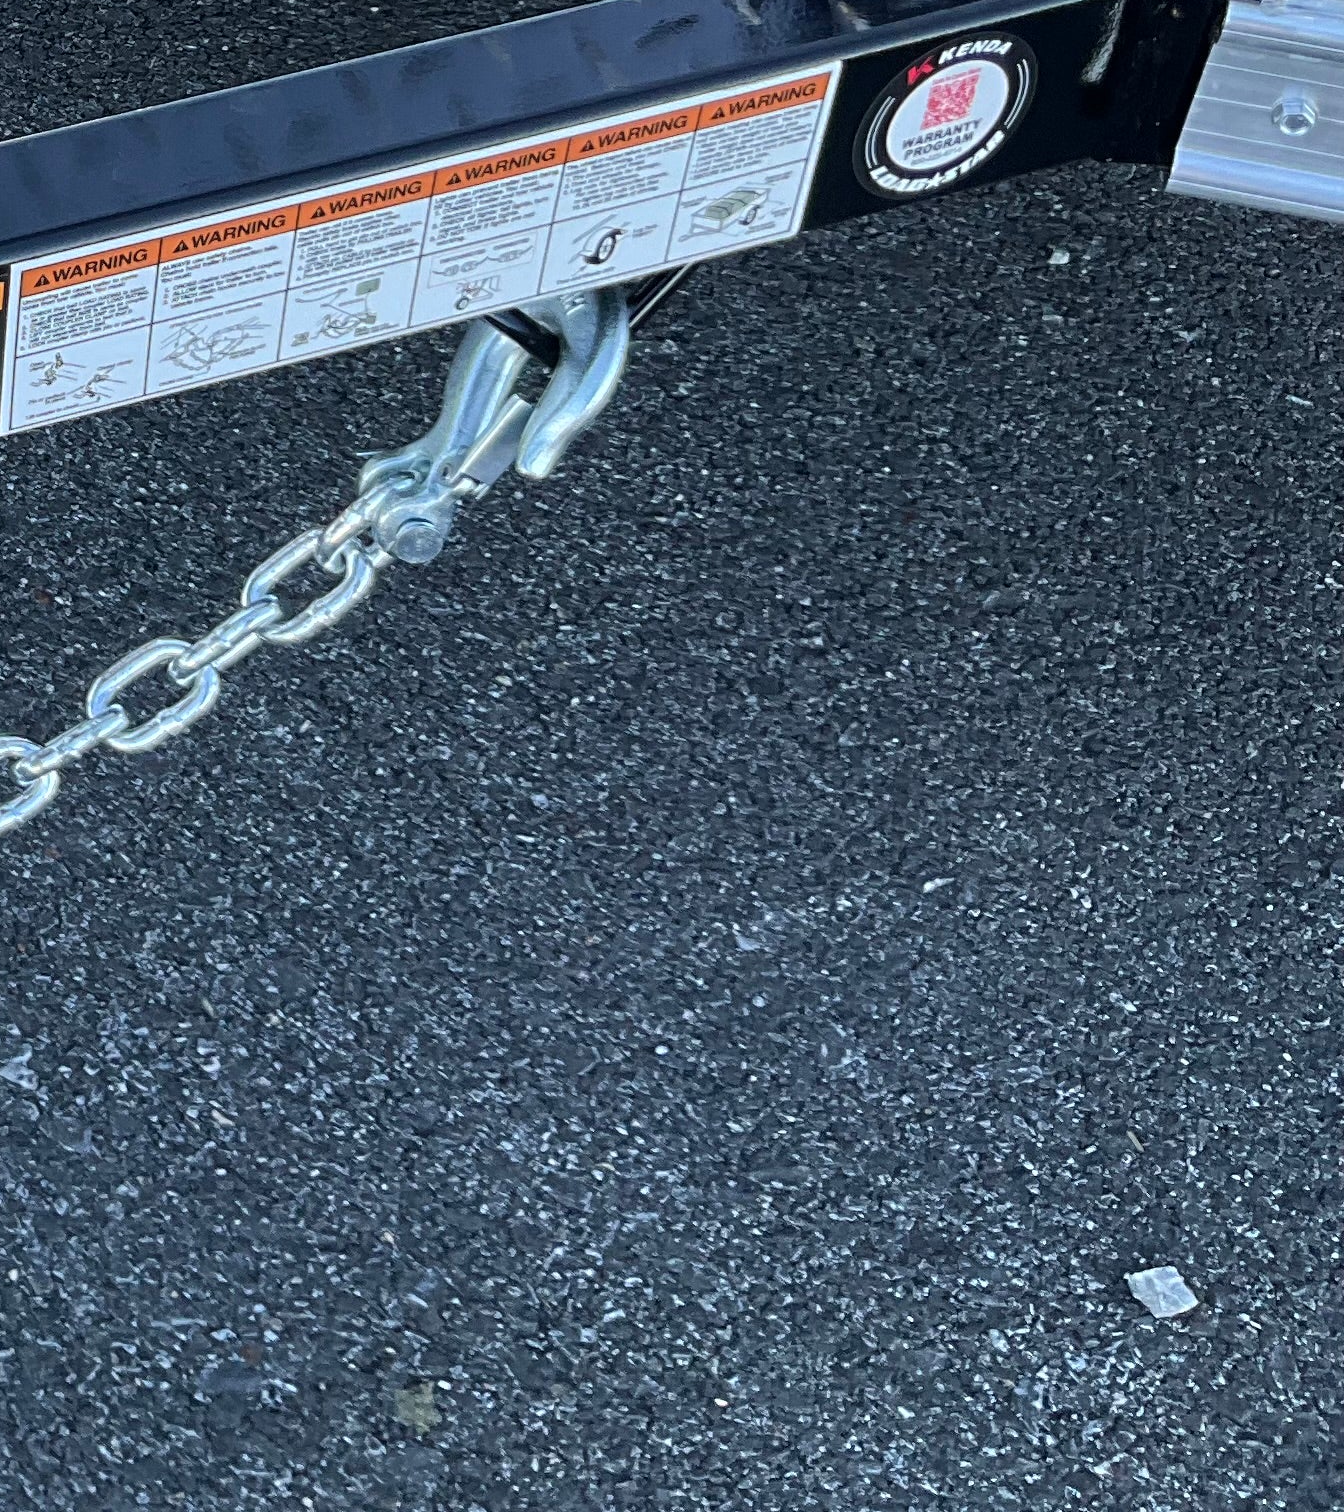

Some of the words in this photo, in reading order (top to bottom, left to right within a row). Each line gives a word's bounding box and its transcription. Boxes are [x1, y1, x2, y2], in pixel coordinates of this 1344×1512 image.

[939, 40, 1013, 65] KENDA
[728, 82, 817, 116] WARNING
[597, 114, 689, 148] WARNING
[903, 118, 984, 149] WARRANTY
[904, 132, 974, 160] PROGRAM
[464, 147, 556, 181] WARNING
[328, 180, 423, 215] WARNING
[191, 215, 287, 249] WARNING
[52, 249, 149, 284] WARNING
